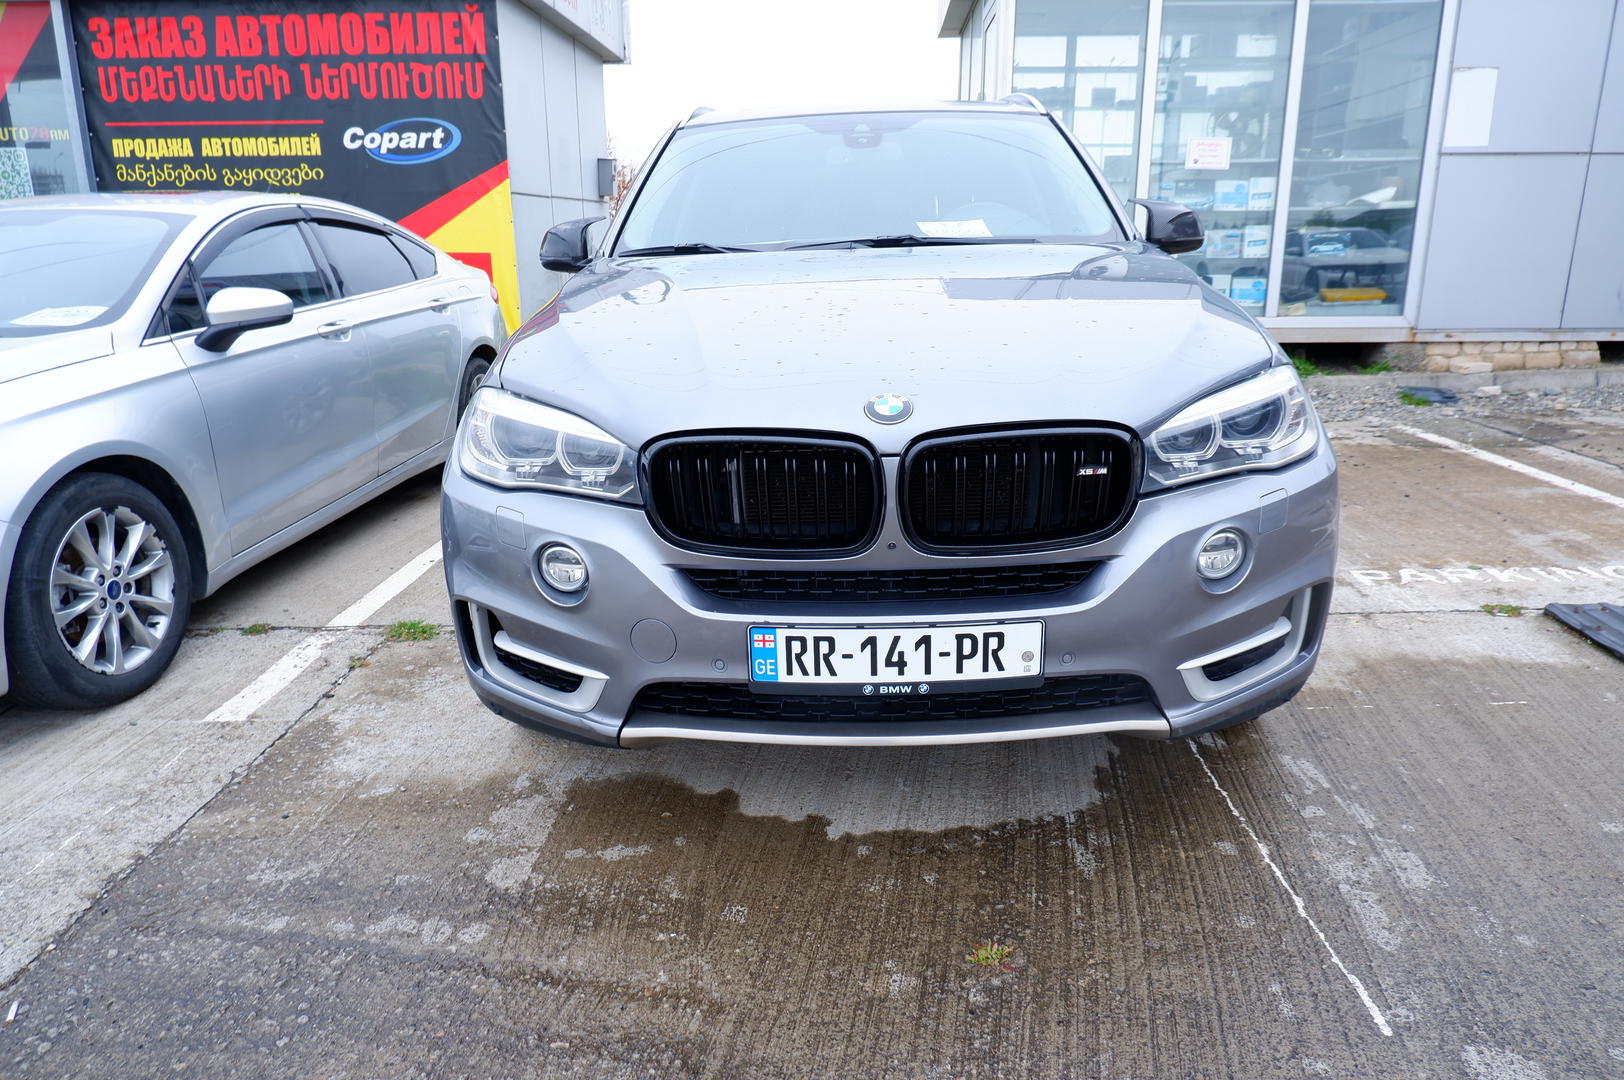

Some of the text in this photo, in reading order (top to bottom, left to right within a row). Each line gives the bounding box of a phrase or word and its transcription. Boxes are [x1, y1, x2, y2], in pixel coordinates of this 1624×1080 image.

[88, 3, 486, 60] ЗАКАЗ АВТОМОБИЛЕЙ
[98, 61, 485, 103] ՄԵՔԵՆԱՆԵՐԻ ՆԵՐՄՈՒԾՈՒՄ
[0, 127, 70, 141] UTO28AM
[112, 133, 322, 160] ПРОДАЖА АВТОМОБИЛЕЙ
[343, 126, 444, 154] Copart
[116, 163, 324, 187] მანქანების გაყიდვები
[755, 659, 776, 676] GE
[785, 631, 1006, 677] RR-141-PR
[879, 685, 912, 694] BMW
